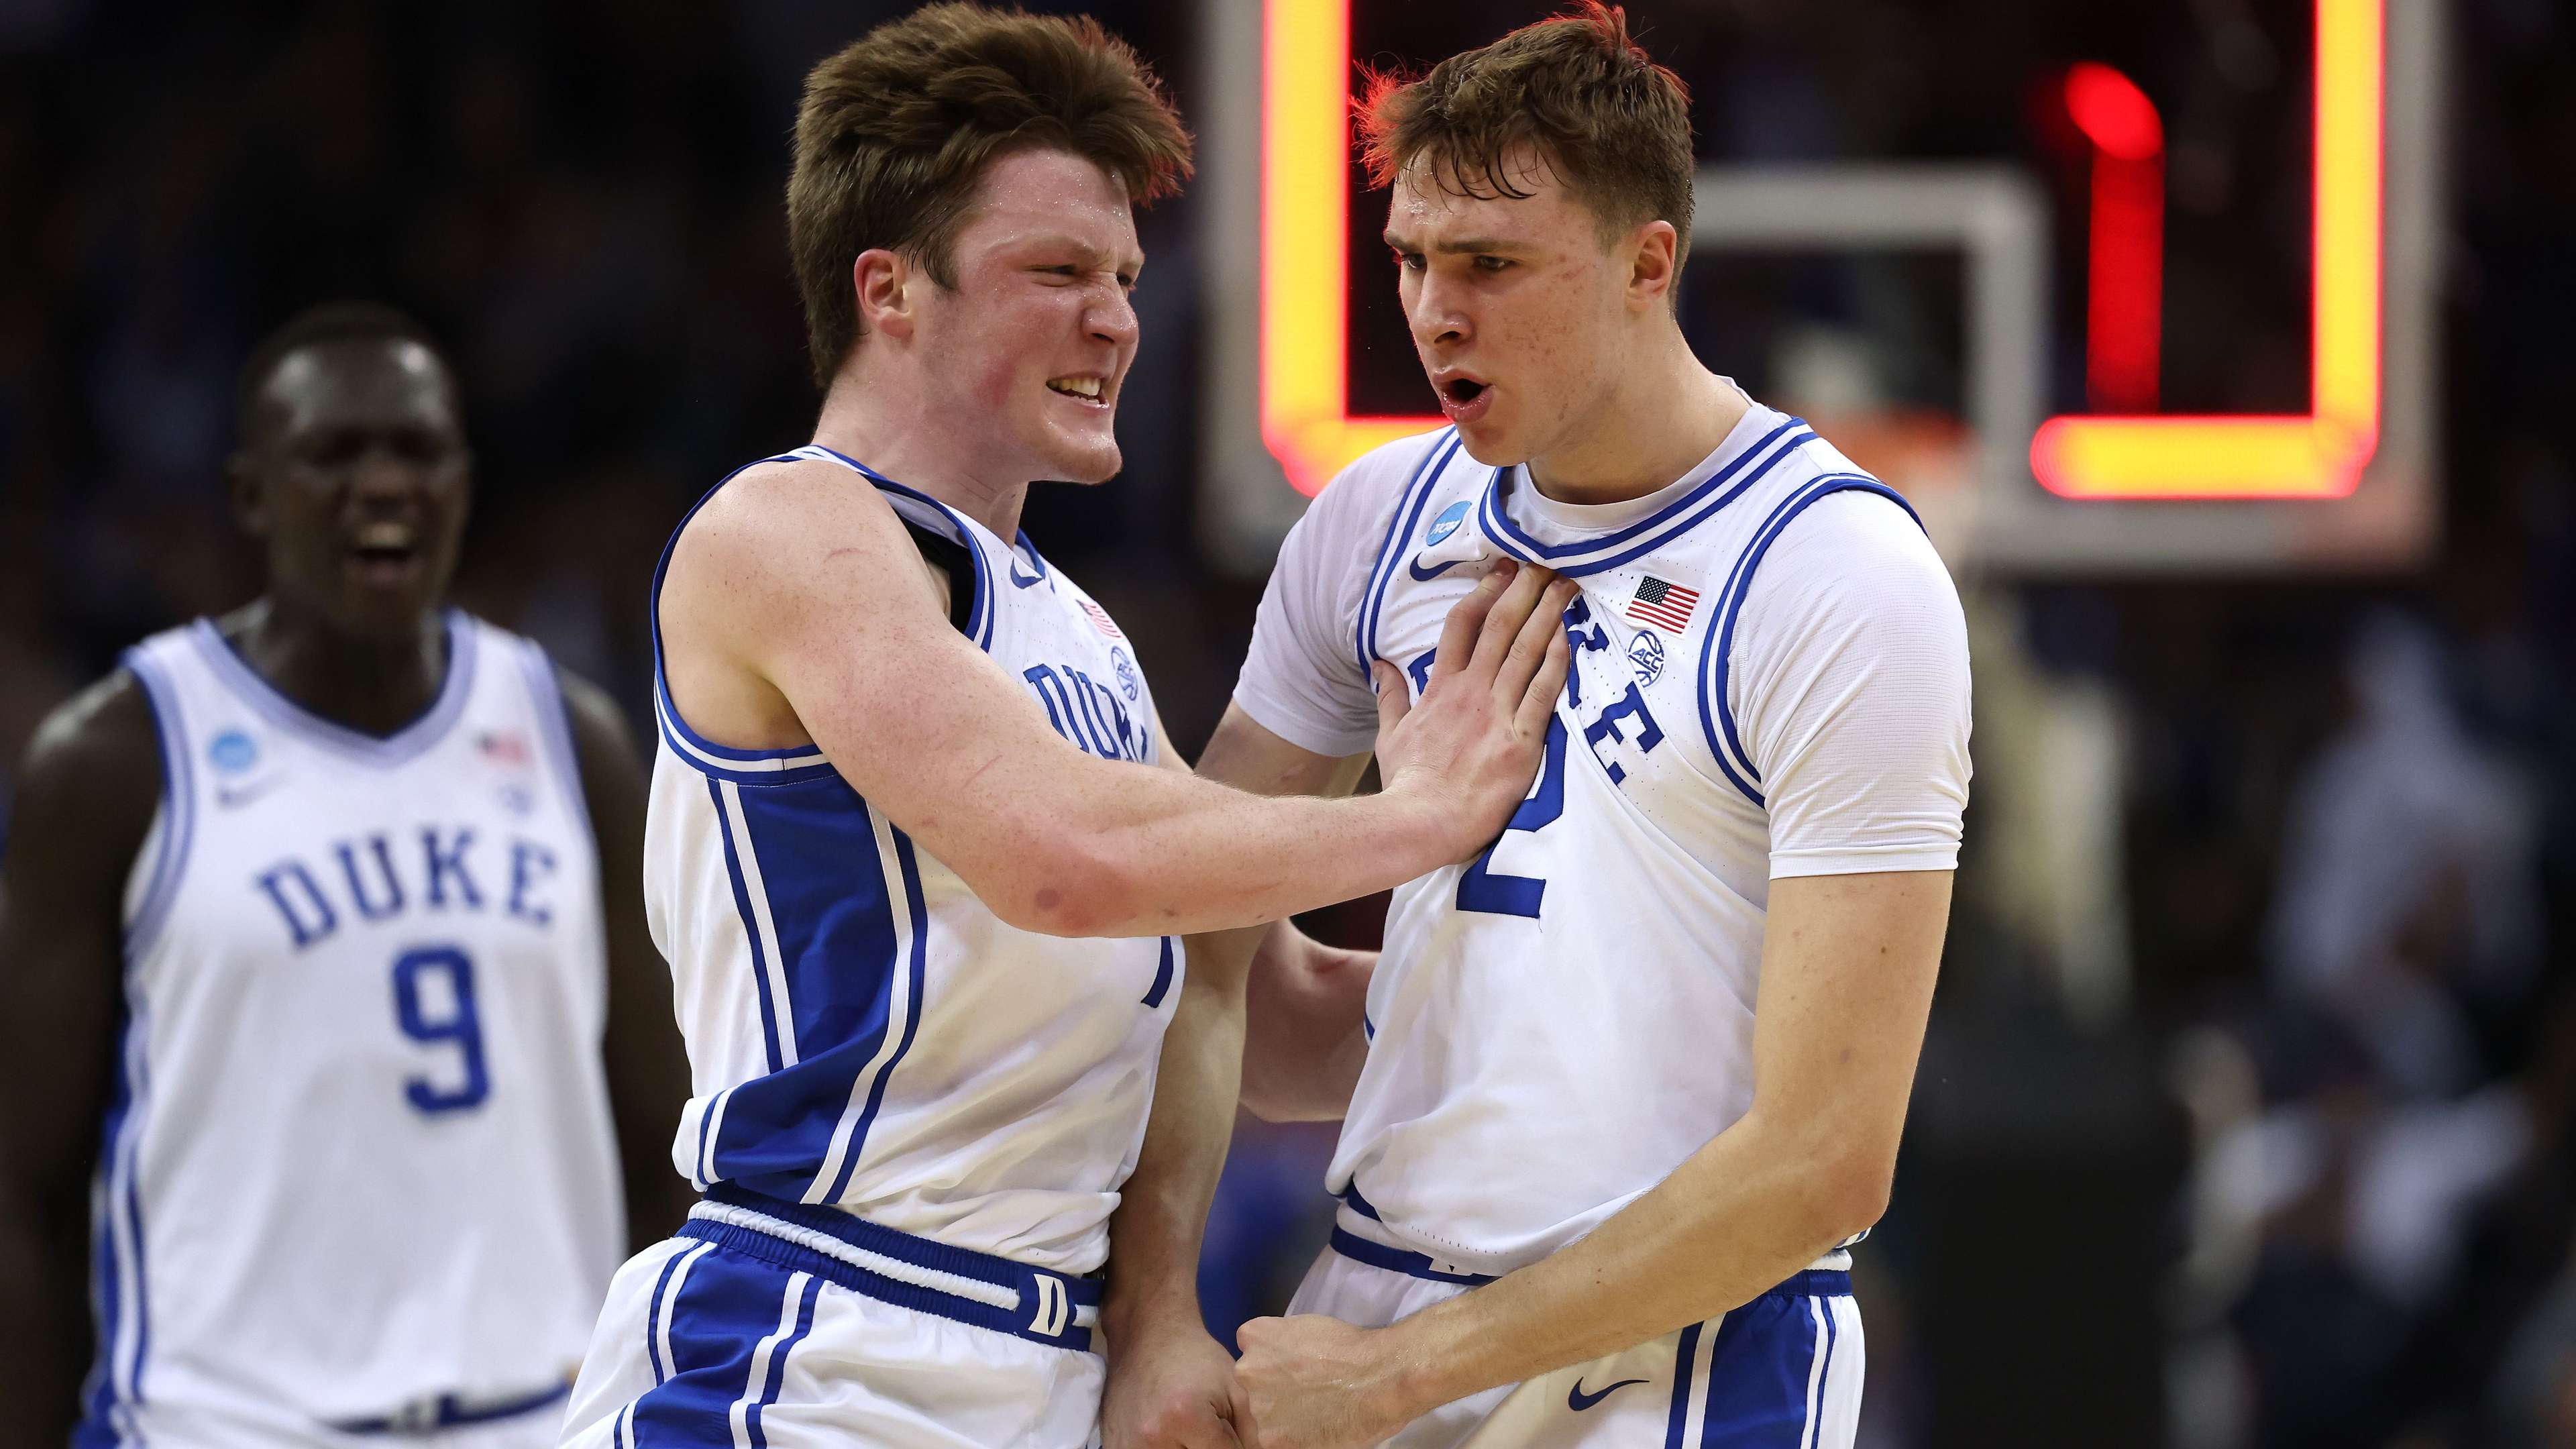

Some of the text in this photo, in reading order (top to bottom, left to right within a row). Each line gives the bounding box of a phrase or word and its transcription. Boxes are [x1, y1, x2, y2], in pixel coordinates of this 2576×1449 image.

[1022, 663, 1147, 762] DUK
[1632, 648, 1664, 670] ACC
[1456, 711, 1568, 918] 2
[253, 824, 558, 950] DUKE
[391, 943, 492, 1119] 9
[1028, 1273, 1069, 1337] D
